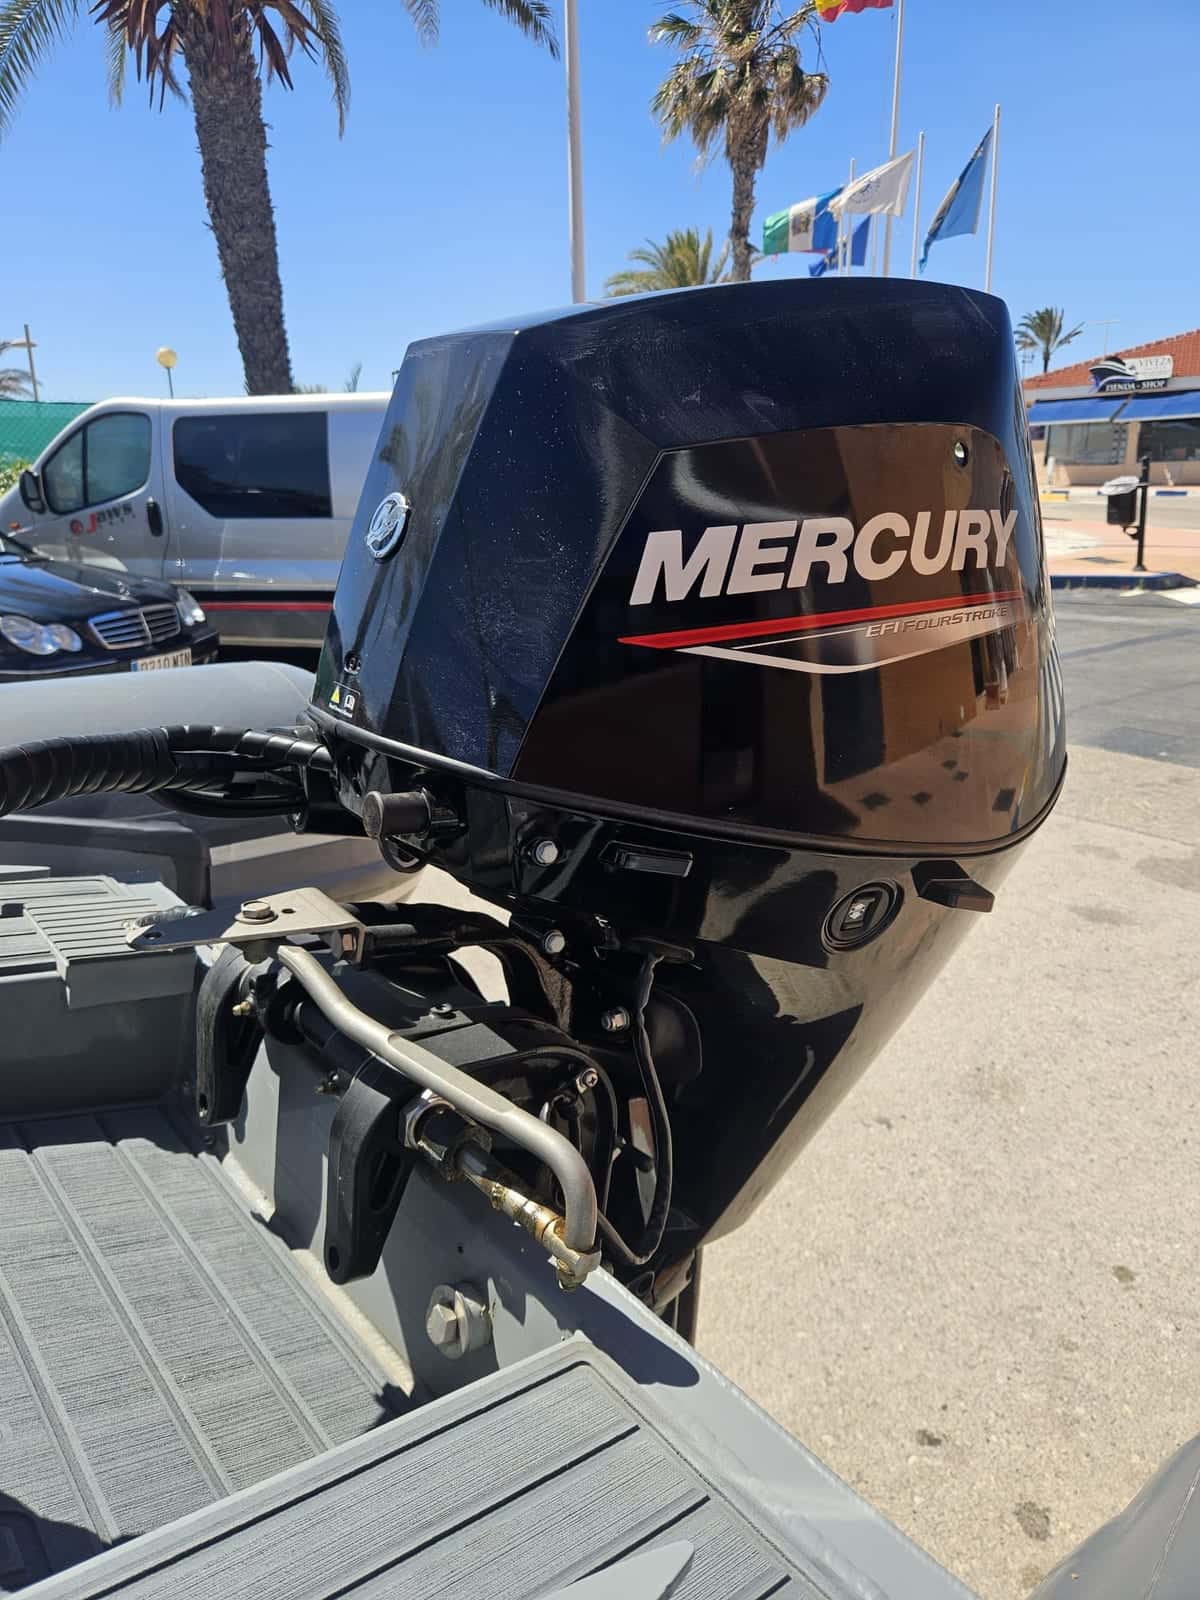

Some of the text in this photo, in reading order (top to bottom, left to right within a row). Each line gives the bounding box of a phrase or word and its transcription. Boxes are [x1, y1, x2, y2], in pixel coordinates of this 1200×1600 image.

[1105, 382, 1136, 392] TIENDA
[1141, 379, 1166, 390] SHOP
[628, 509, 1019, 606] MERCURY
[865, 621, 900, 637] EFI
